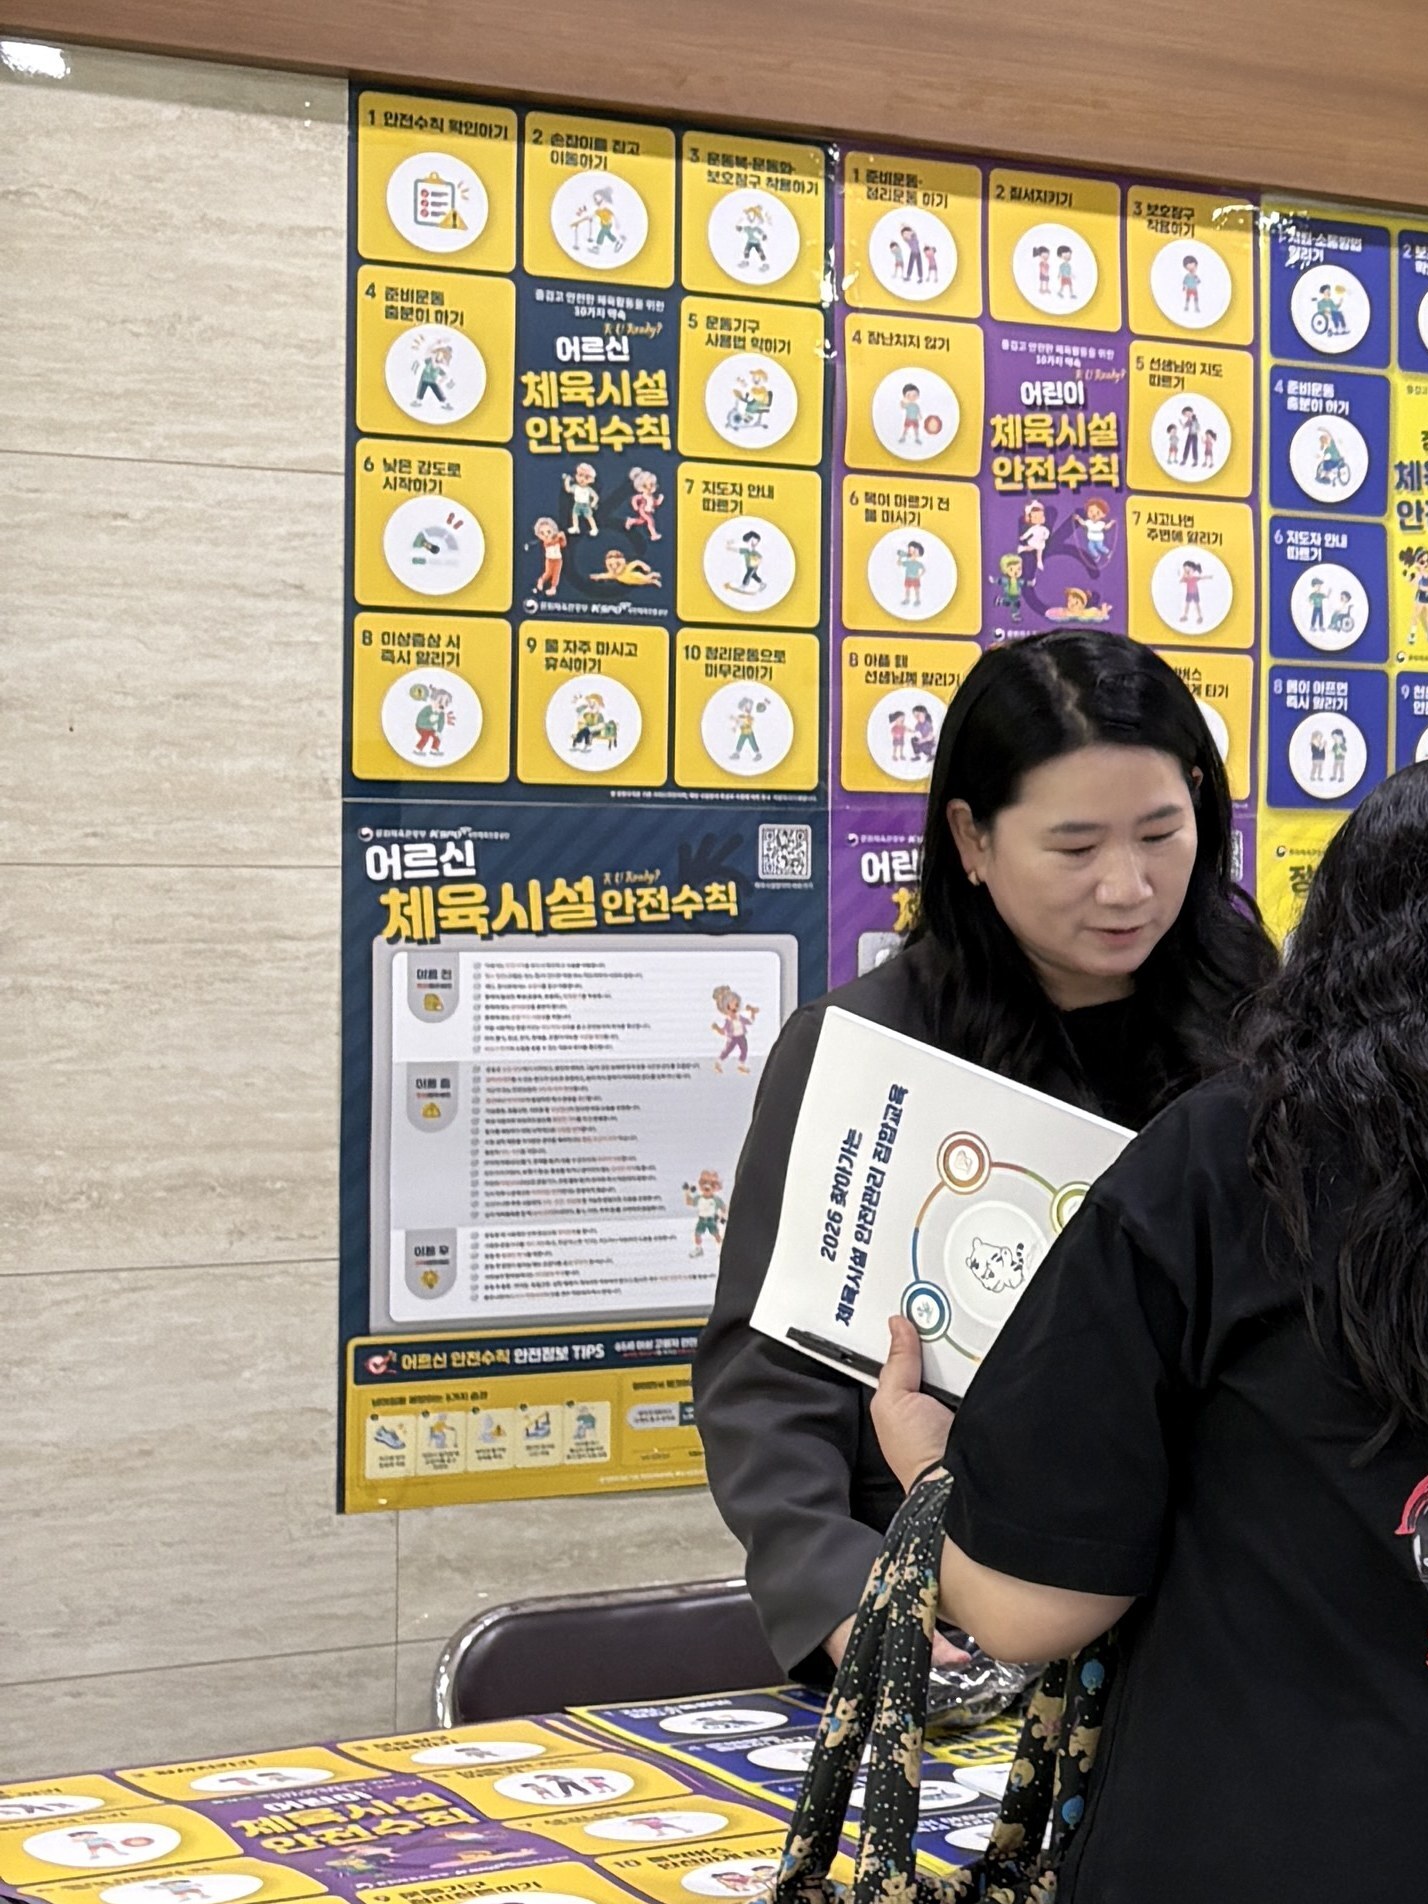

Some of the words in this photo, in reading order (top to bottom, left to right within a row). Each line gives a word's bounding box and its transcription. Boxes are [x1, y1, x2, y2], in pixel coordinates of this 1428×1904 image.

[556, 335, 630, 362] 어르신
[520, 369, 669, 409] 체육시설
[1020, 380, 1085, 406] 어린이
[525, 413, 672, 454] 안전수칙
[990, 412, 1119, 451] 체육시설
[991, 454, 1120, 492] 안전수칙
[365, 839, 477, 881] 어르신
[379, 875, 597, 940] 체육시설
[601, 880, 738, 924] 안전수칙
[829, 1127, 863, 1206] 찾아가는
[835, 1246, 868, 1327] 체육시설
[853, 1166, 886, 1246] 안전관리
[872, 1082, 909, 1165] 집합교육
[820, 1213, 845, 1263] 2026
[401, 1352, 447, 1370] 어르신
[450, 1348, 511, 1368] 안전수칙
[514, 1347, 569, 1364] 안전정보
[571, 1343, 605, 1360] TIPS
[231, 1793, 452, 1838] 체육시설
[261, 1808, 480, 1854] 안전수칙
